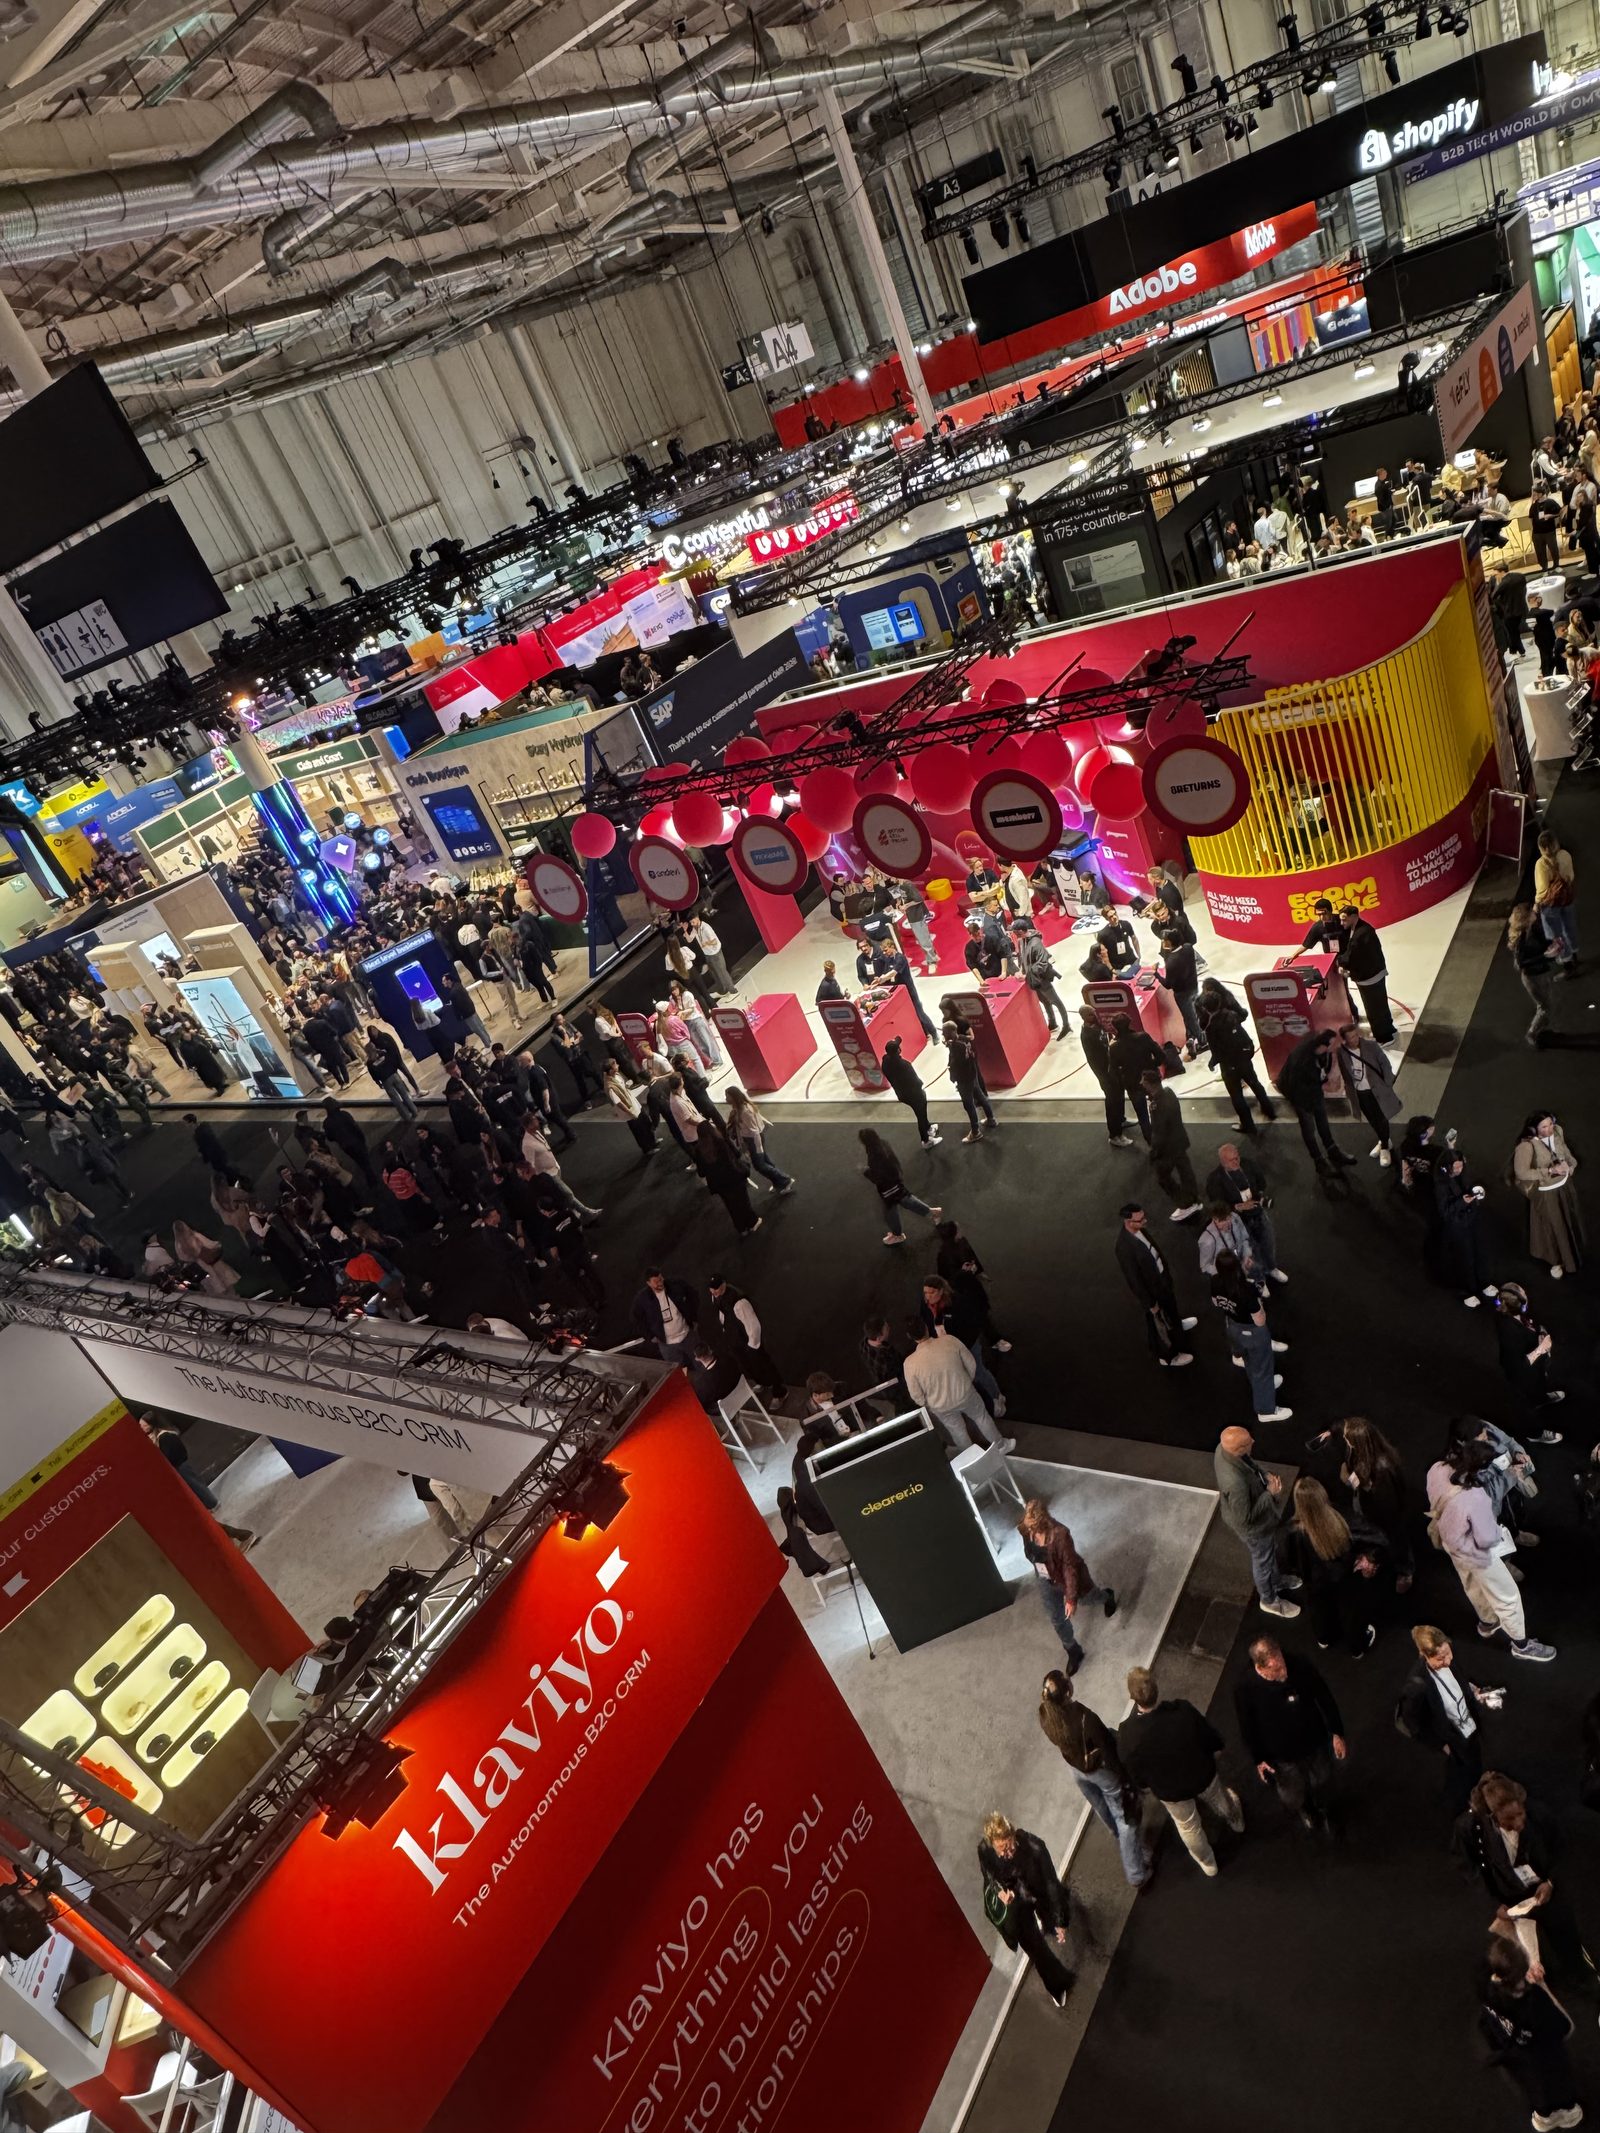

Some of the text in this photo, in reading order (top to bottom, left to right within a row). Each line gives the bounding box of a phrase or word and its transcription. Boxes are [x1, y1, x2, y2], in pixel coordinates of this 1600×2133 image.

[1393, 97, 1479, 156] shopify
[1441, 146, 1465, 163] B2B
[1466, 130, 1498, 153] TECH
[1500, 112, 1548, 139] WORLD
[1550, 101, 1567, 119] BY
[942, 181, 960, 200] A3
[1244, 220, 1277, 259] Adobe
[1109, 261, 1197, 316] Adobe
[772, 333, 799, 369] A4
[683, 506, 770, 552] contentful
[1043, 530, 1054, 543] in
[1055, 525, 1080, 541] 175+
[1082, 510, 1131, 532] countrie
[650, 700, 674, 727] SAP
[668, 735, 687, 753] Thank
[686, 730, 697, 744] you
[696, 724, 704, 734] to
[703, 718, 712, 730] our
[712, 700, 739, 723] customers
[738, 692, 748, 705] and
[747, 678, 769, 699] partners
[297, 751, 344, 773] Club and Court
[406, 764, 470, 788] Club Boutique
[106, 803, 136, 823] ADCELL
[1406, 833, 1459, 872] ALL YOU NEED
[1407, 841, 1462, 881] TO MAKE YOUR
[1287, 876, 1378, 909] ECOM
[1409, 858, 1455, 892] BRAND POP
[1207, 890, 1257, 906] ALL YOU NEED
[1209, 900, 1263, 915] TO MAKE YOUR
[1211, 909, 1252, 923] BRAND POP
[364, 932, 432, 971] Next level business AI
[175, 1366, 472, 1453] The Autonomous B2C CRM
[24, 1464, 113, 1543] customers.
[861, 1483, 924, 1516] clearer.io
[392, 1599, 624, 1897] klaviyo
[452, 1648, 652, 1928] The Autonomous B2C CRM
[592, 1802, 764, 2081] Klaviyo has
[719, 1943, 791, 2073] build
[788, 1800, 874, 1946] lasting
[624, 1793, 824, 2133] erything you
